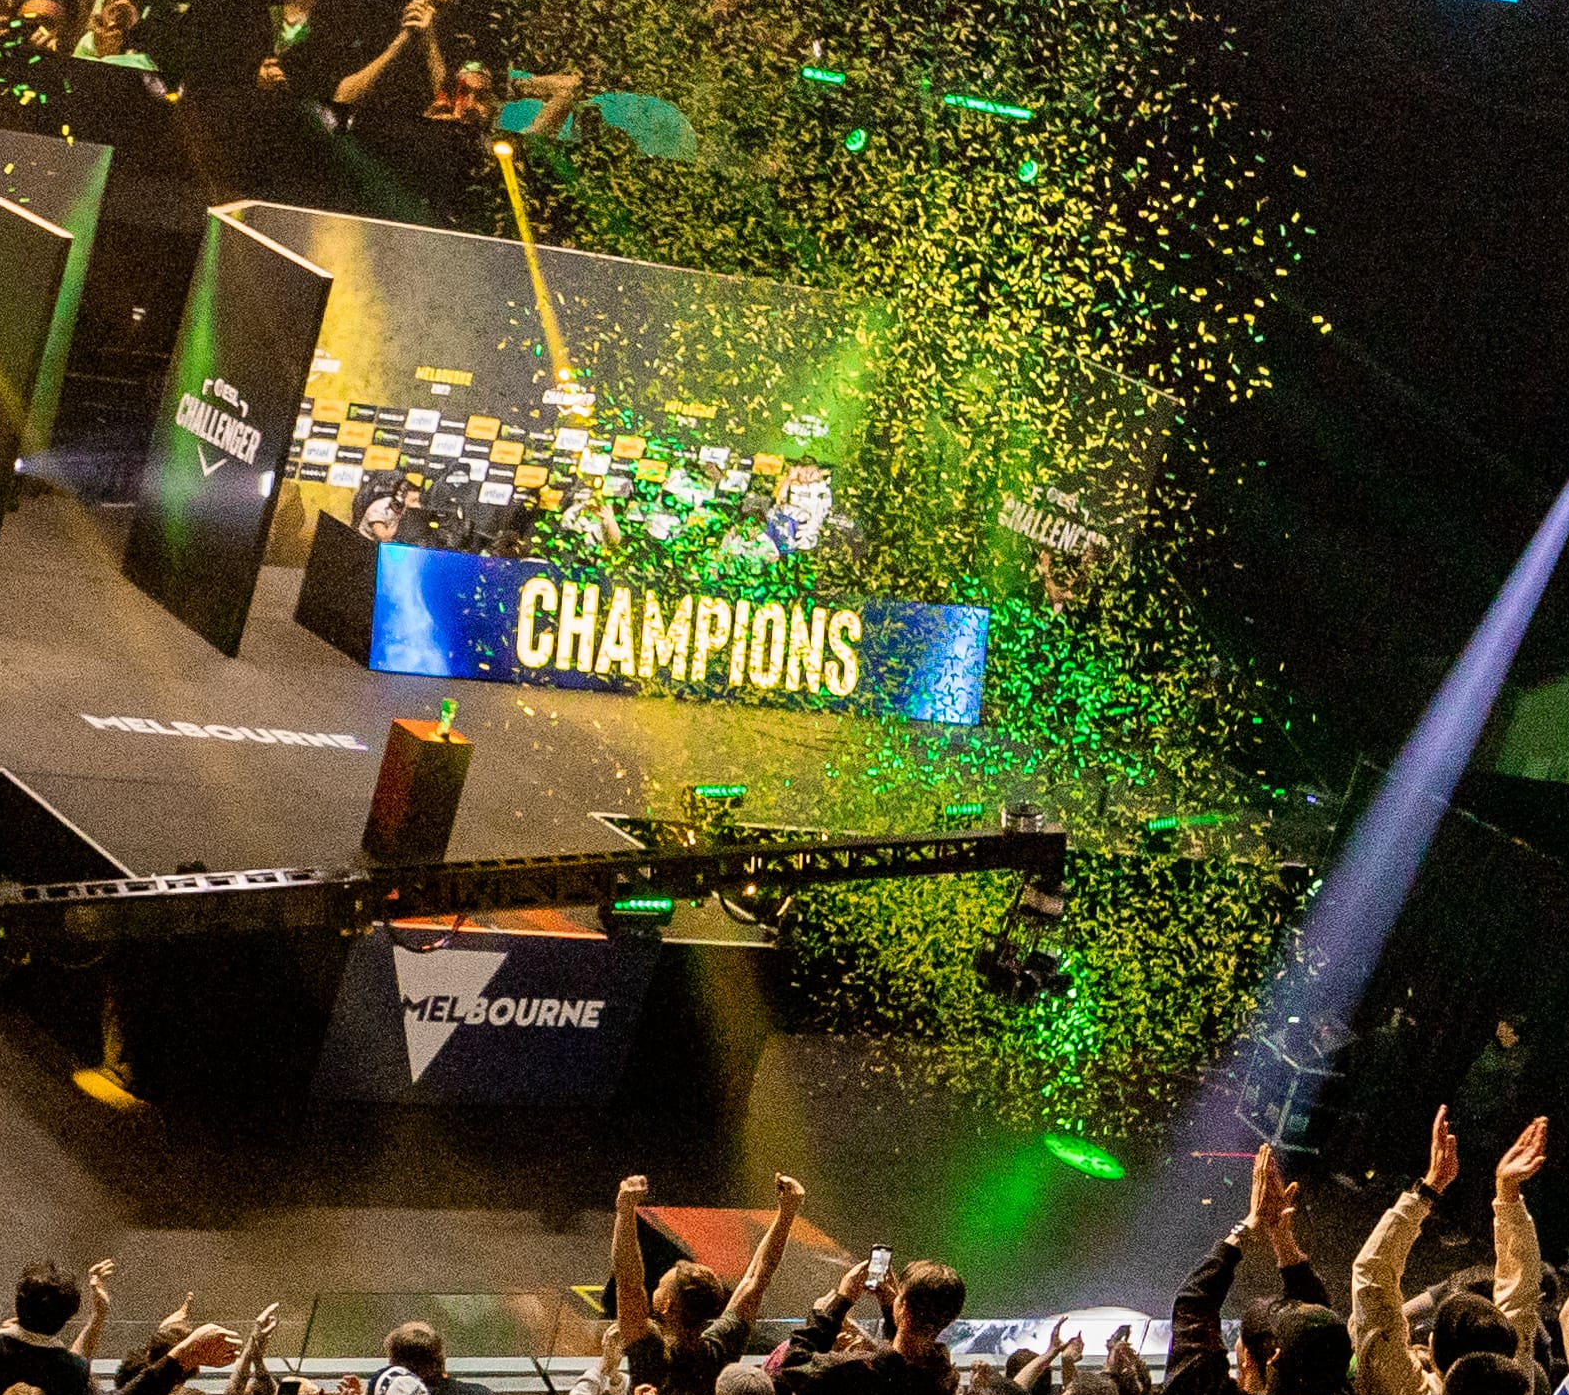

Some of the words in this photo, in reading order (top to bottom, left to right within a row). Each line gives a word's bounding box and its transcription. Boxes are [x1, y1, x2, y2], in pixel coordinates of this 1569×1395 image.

[175, 393, 263, 465] CHALLENGER
[516, 577, 862, 696] CHAMPIONS
[80, 712, 368, 752] MELBOURNE
[400, 994, 606, 1028] MELBOURNE
